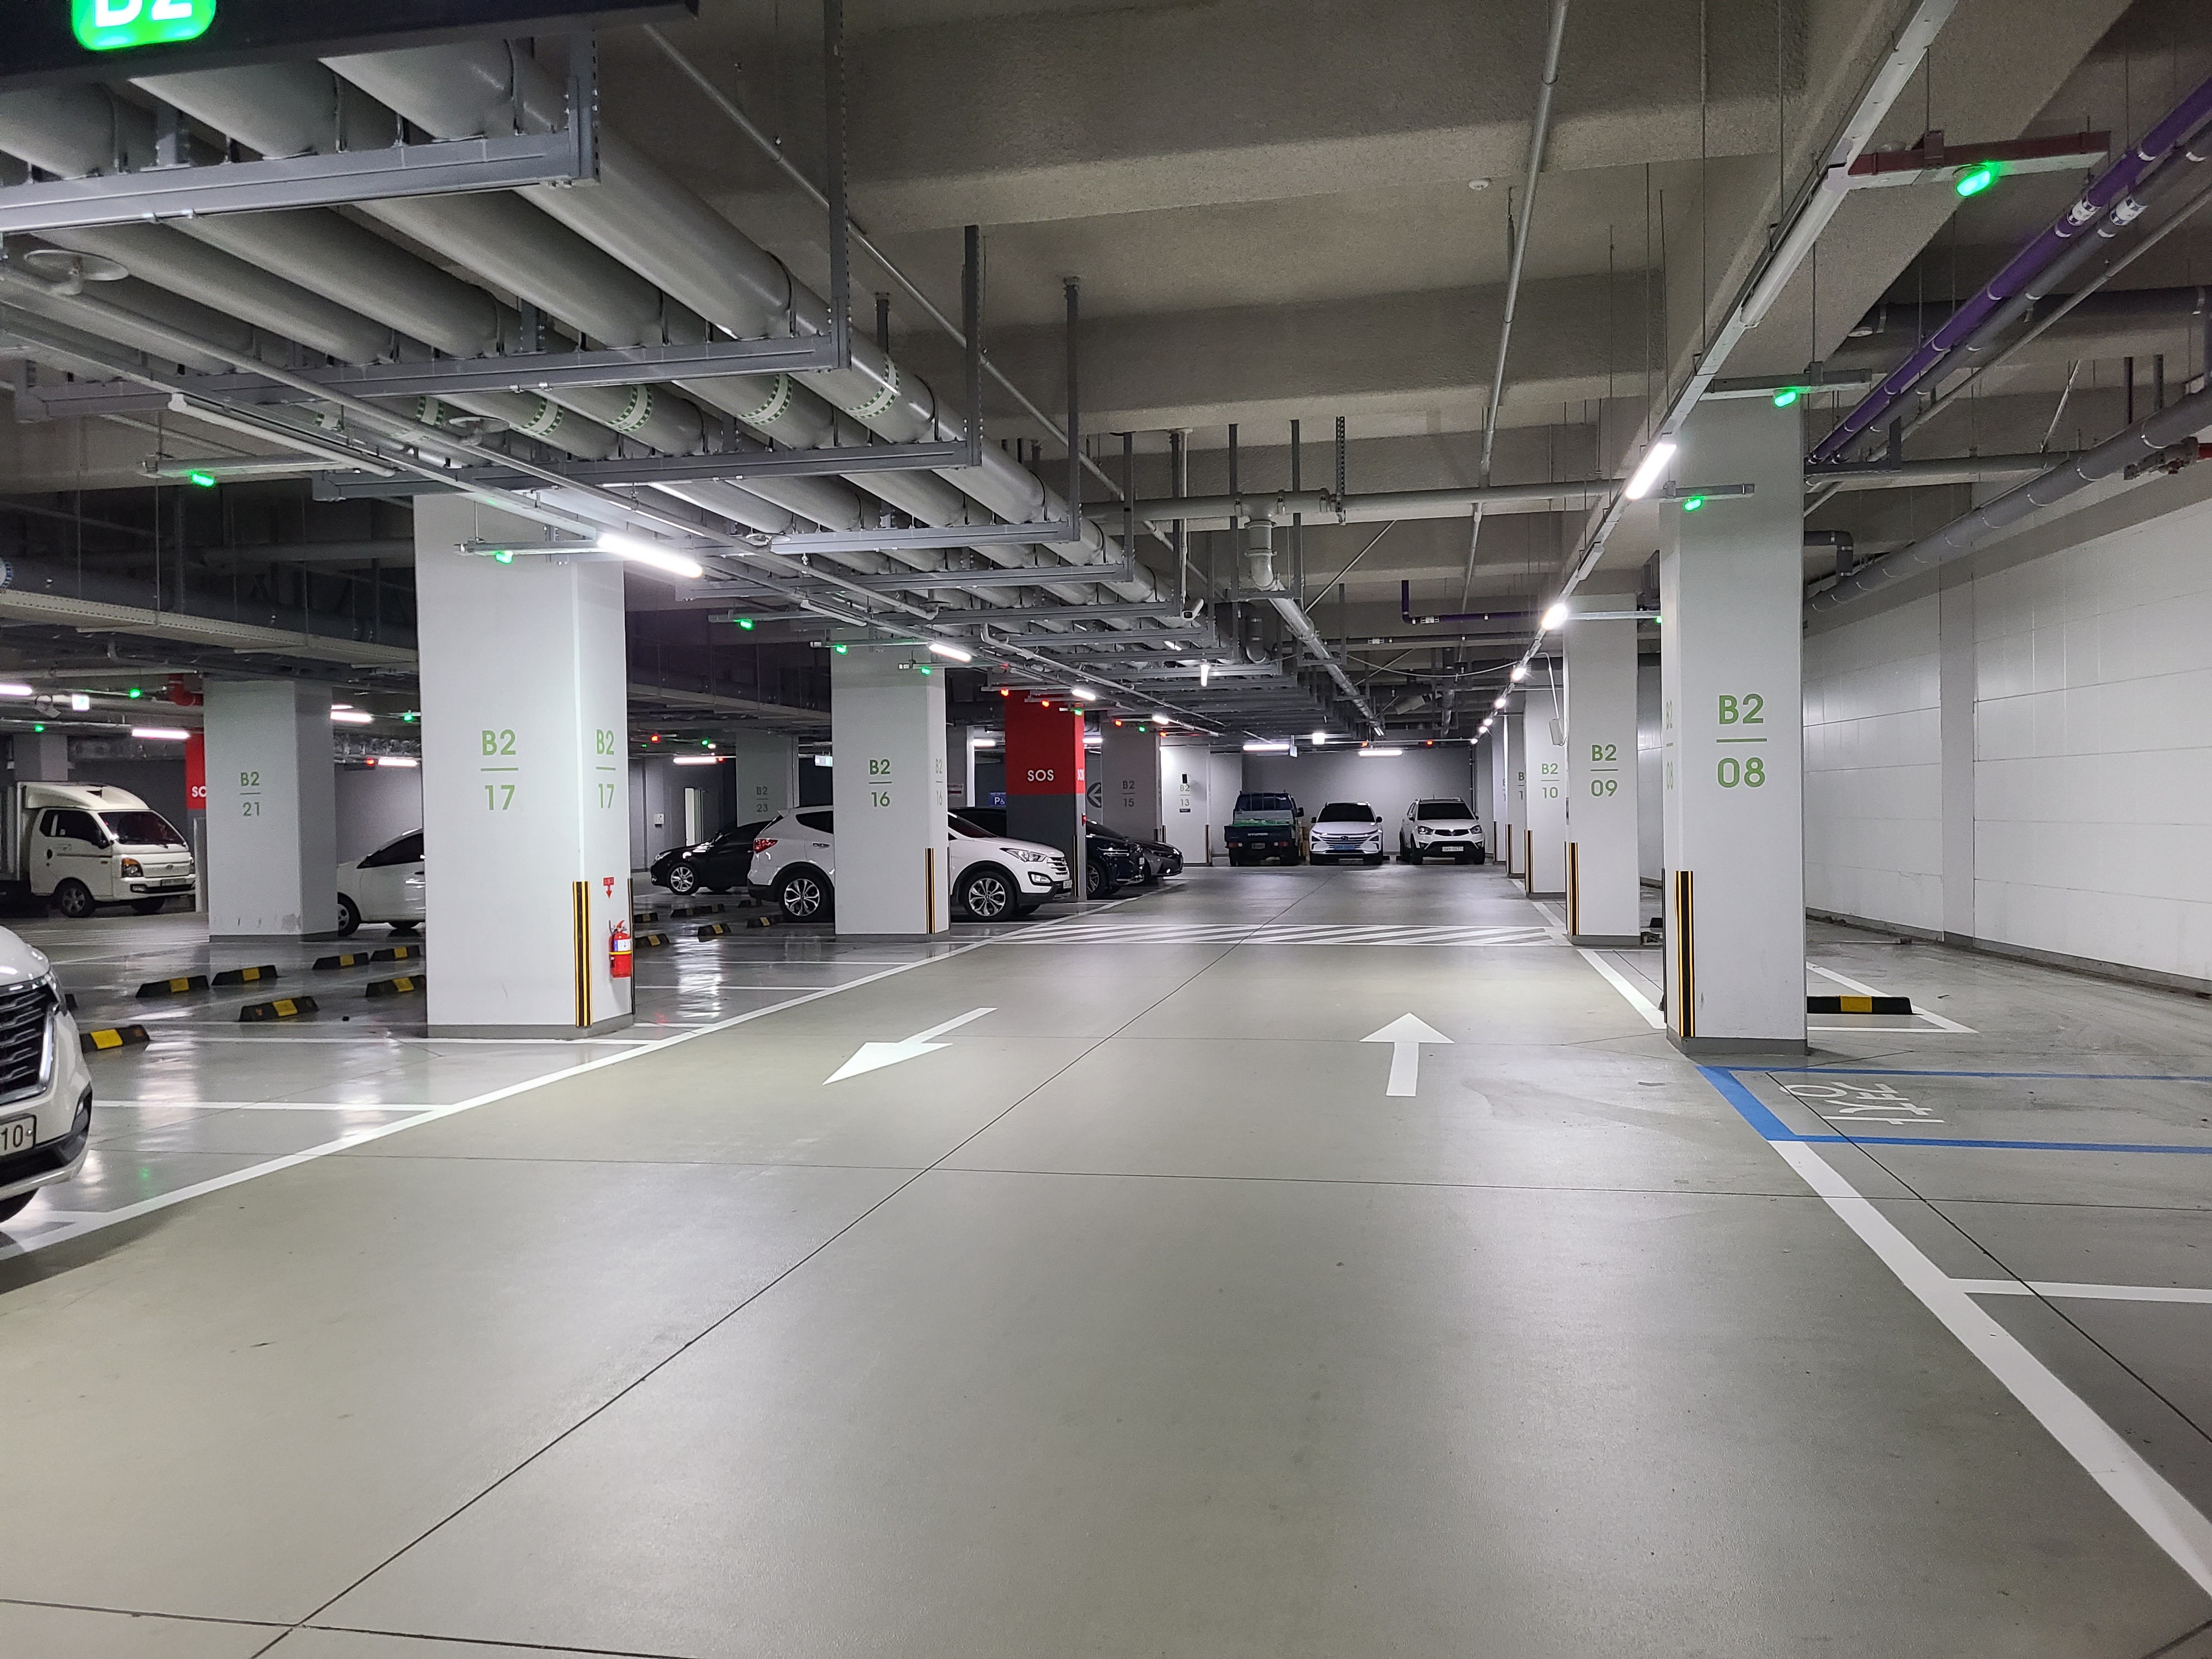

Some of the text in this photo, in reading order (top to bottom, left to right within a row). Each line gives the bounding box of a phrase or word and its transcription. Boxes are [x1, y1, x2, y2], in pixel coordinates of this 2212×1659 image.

[1666, 699, 1673, 730] B2
[1719, 694, 1764, 725] B2
[482, 729, 516, 756] B2
[596, 730, 614, 755] B2
[1592, 744, 1617, 762] B2
[869, 759, 890, 775] B2
[935, 758, 943, 774] B2
[1542, 763, 1558, 775] B2
[1718, 758, 1765, 788] 08
[241, 771, 259, 786] B2
[1027, 769, 1054, 782] SOS
[1518, 771, 1525, 781] B
[1666, 761, 1673, 791] 08
[191, 786, 207, 798] SO
[757, 786, 768, 795] B2
[1122, 780, 1135, 789] B2
[1180, 783, 1190, 792] B2
[1591, 780, 1618, 798] 09
[484, 785, 516, 811] 17
[598, 784, 614, 809] 17
[871, 792, 890, 808] 16
[936, 790, 943, 806] 16
[1542, 787, 1558, 799] 10
[243, 802, 259, 816] 21
[757, 804, 768, 812] 23
[1124, 798, 1135, 807] 15
[1779, 1081, 1946, 1125] 경차
